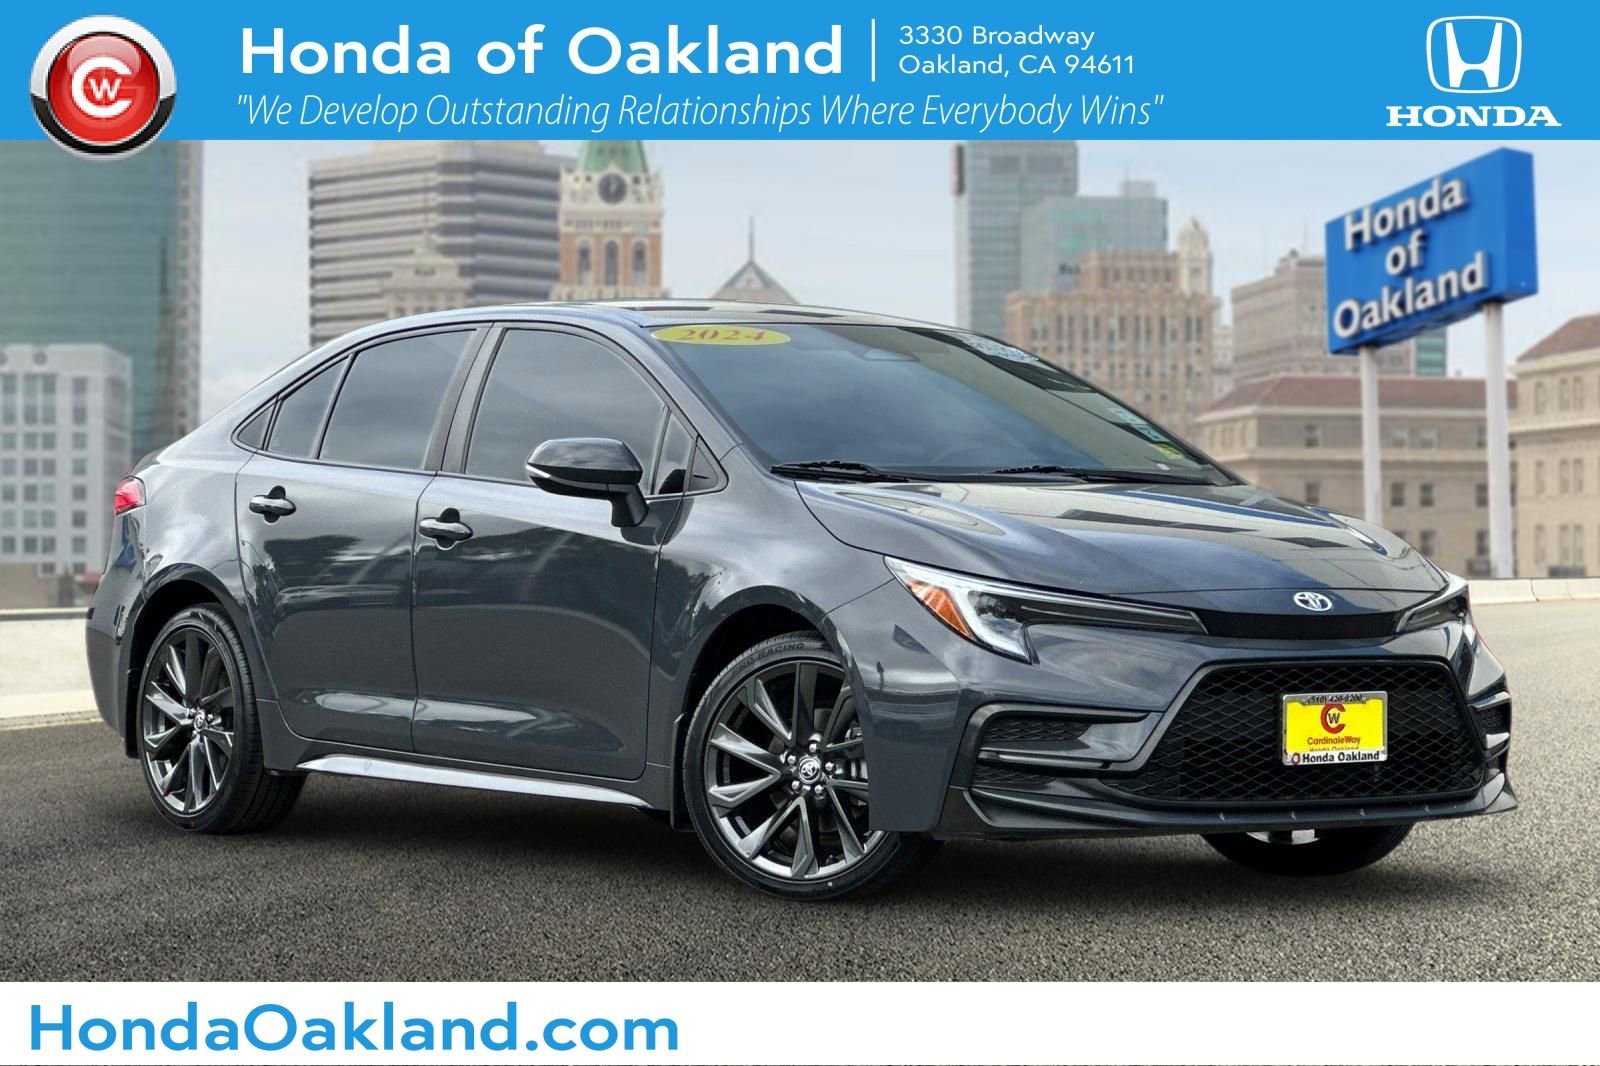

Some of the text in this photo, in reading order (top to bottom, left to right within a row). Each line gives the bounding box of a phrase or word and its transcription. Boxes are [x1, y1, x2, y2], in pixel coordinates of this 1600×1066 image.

[1344, 175, 1467, 251] Honda
[1385, 229, 1424, 276] of
[1333, 251, 1488, 338] Oakland
[678, 329, 766, 341] 2024
[1307, 736, 1361, 745] CardinaleWay
[1302, 751, 1380, 763] Honda Oakland
